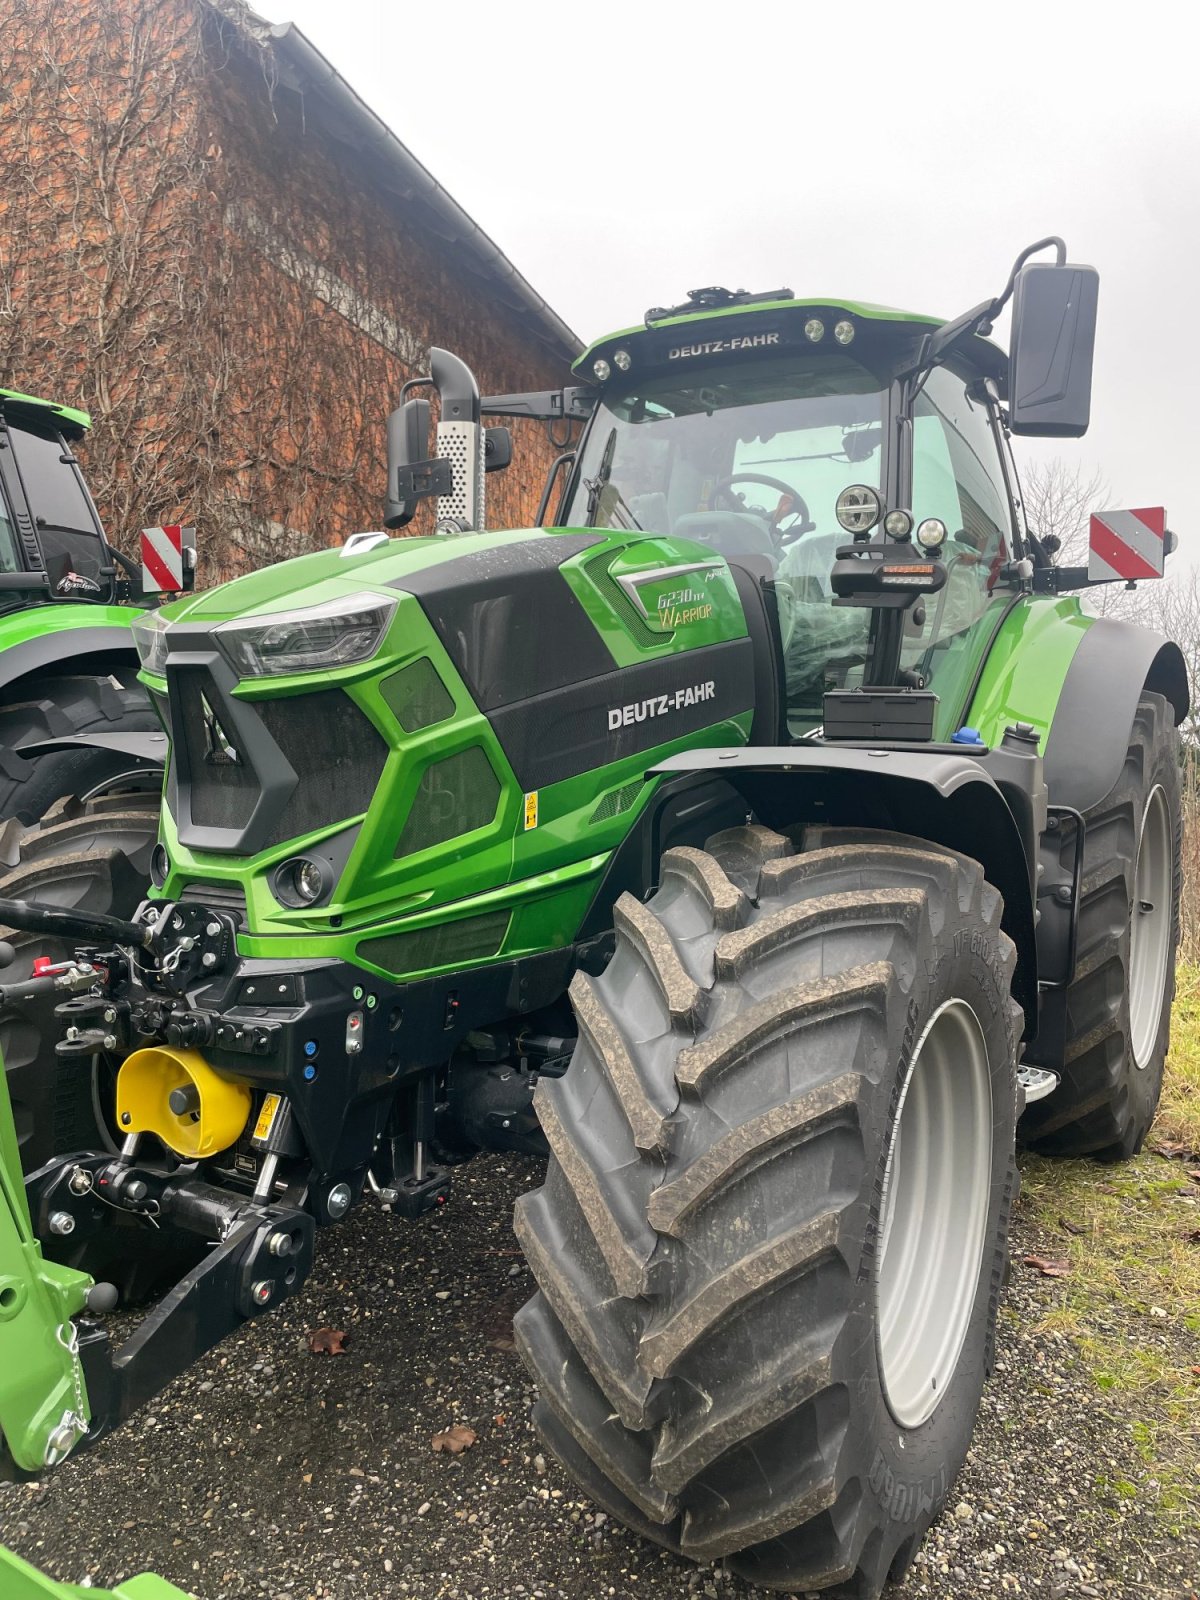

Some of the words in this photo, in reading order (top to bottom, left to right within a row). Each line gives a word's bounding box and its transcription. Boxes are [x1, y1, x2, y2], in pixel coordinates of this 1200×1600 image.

[668, 333, 780, 360] DEUTZ-FAHR
[657, 588, 692, 610] 6230
[658, 603, 713, 629] WARRIOR
[607, 680, 716, 731] DEUTZ-FAHR
